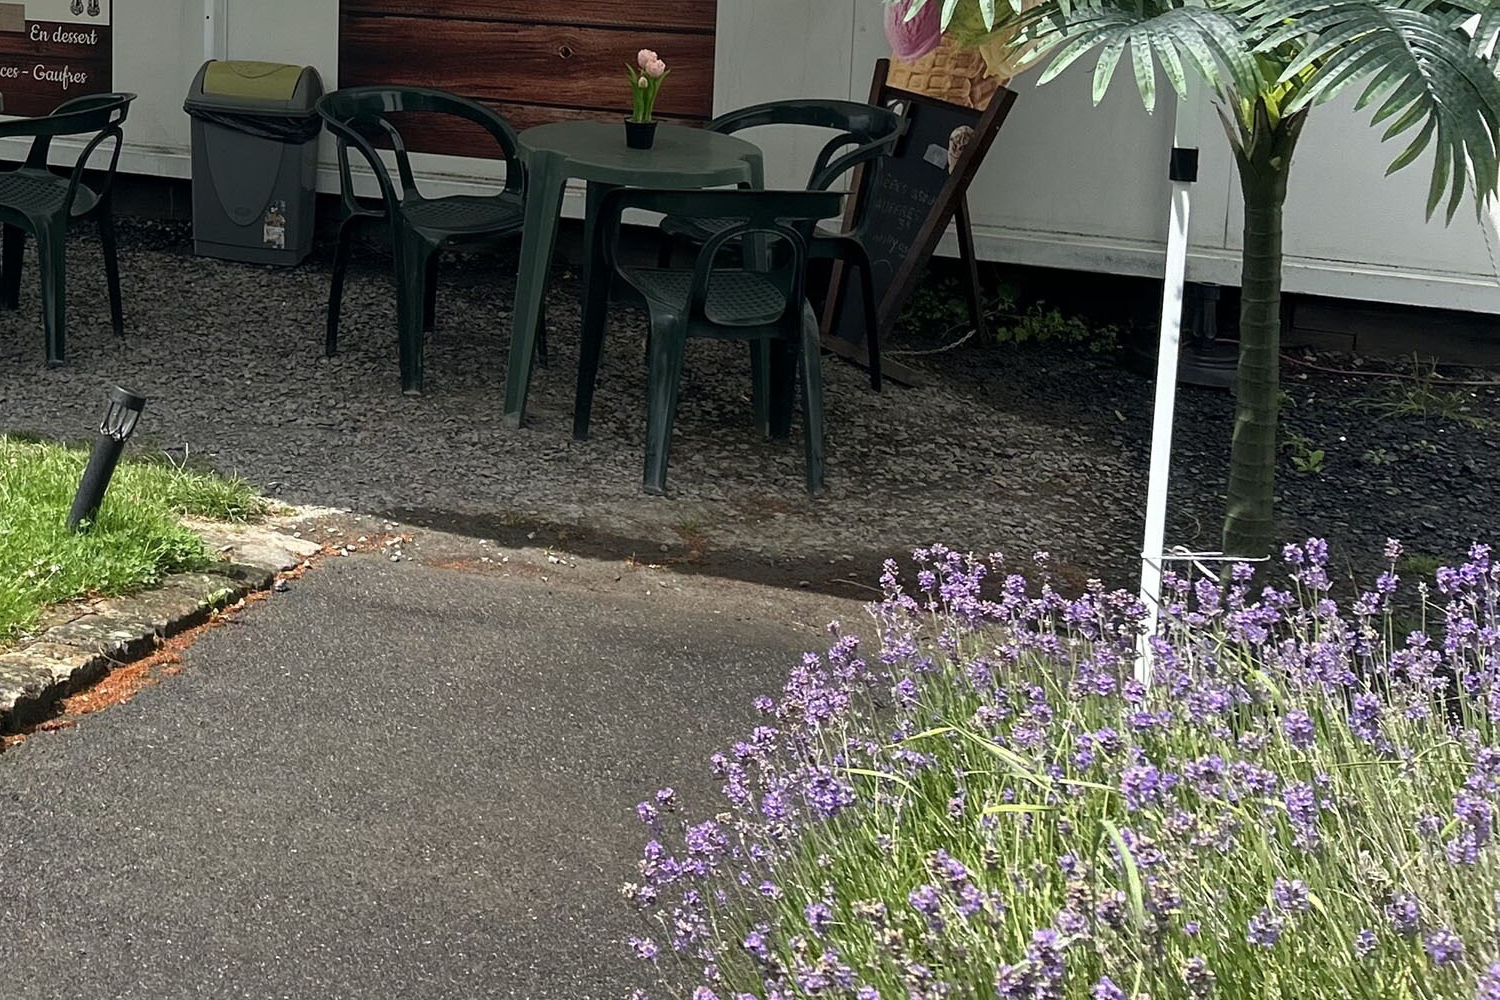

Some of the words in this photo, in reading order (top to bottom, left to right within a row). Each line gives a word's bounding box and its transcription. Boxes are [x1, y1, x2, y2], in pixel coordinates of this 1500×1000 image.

[30, 24, 50, 41] En
[52, 25, 98, 45] dessert
[33, 64, 88, 91] Gaufres
